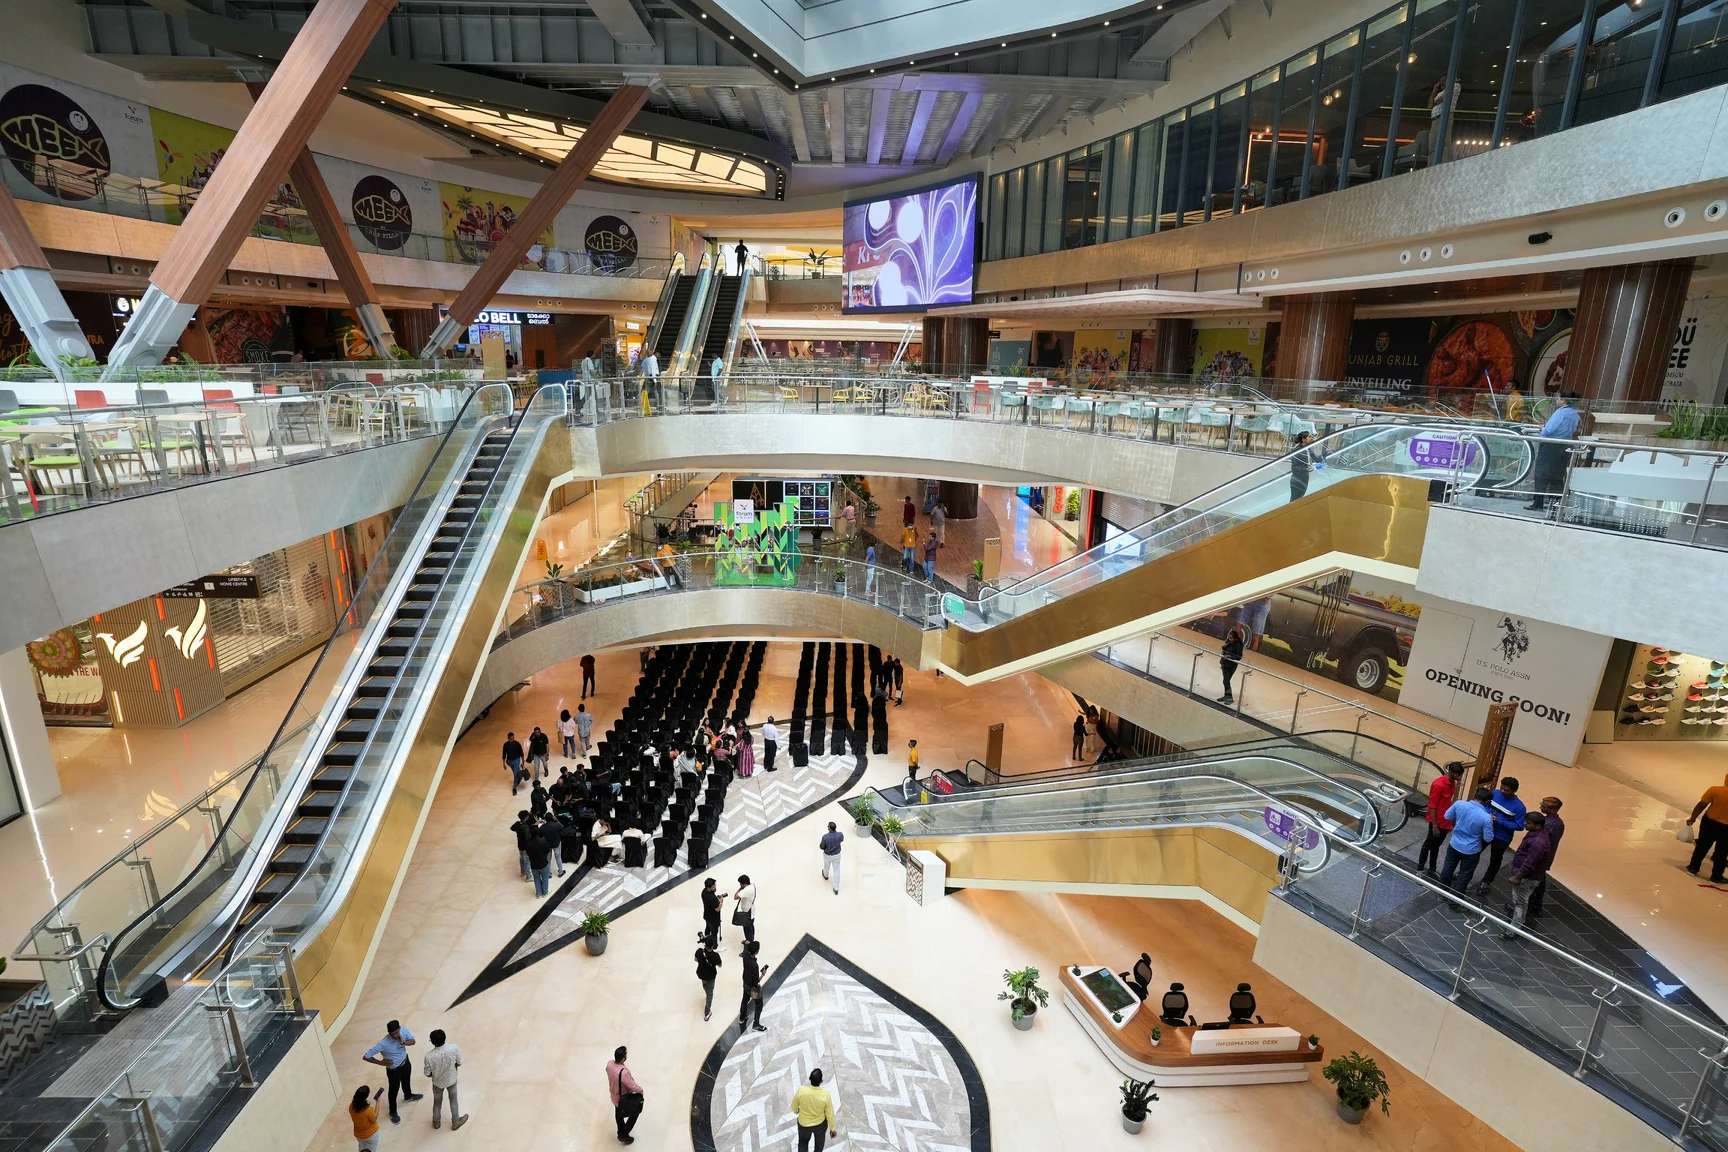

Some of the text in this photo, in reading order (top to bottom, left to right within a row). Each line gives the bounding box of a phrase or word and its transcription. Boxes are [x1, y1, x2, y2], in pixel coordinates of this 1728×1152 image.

[491, 313, 521, 324] BELL
[245, 350, 270, 363] SMOKE
[1348, 355, 1419, 367] UNJAB GRILL
[1668, 348, 1691, 369] EE
[1344, 376, 1412, 391] UNVEILING
[1490, 663, 1510, 675] POLO
[1425, 668, 1504, 704] OPENING
